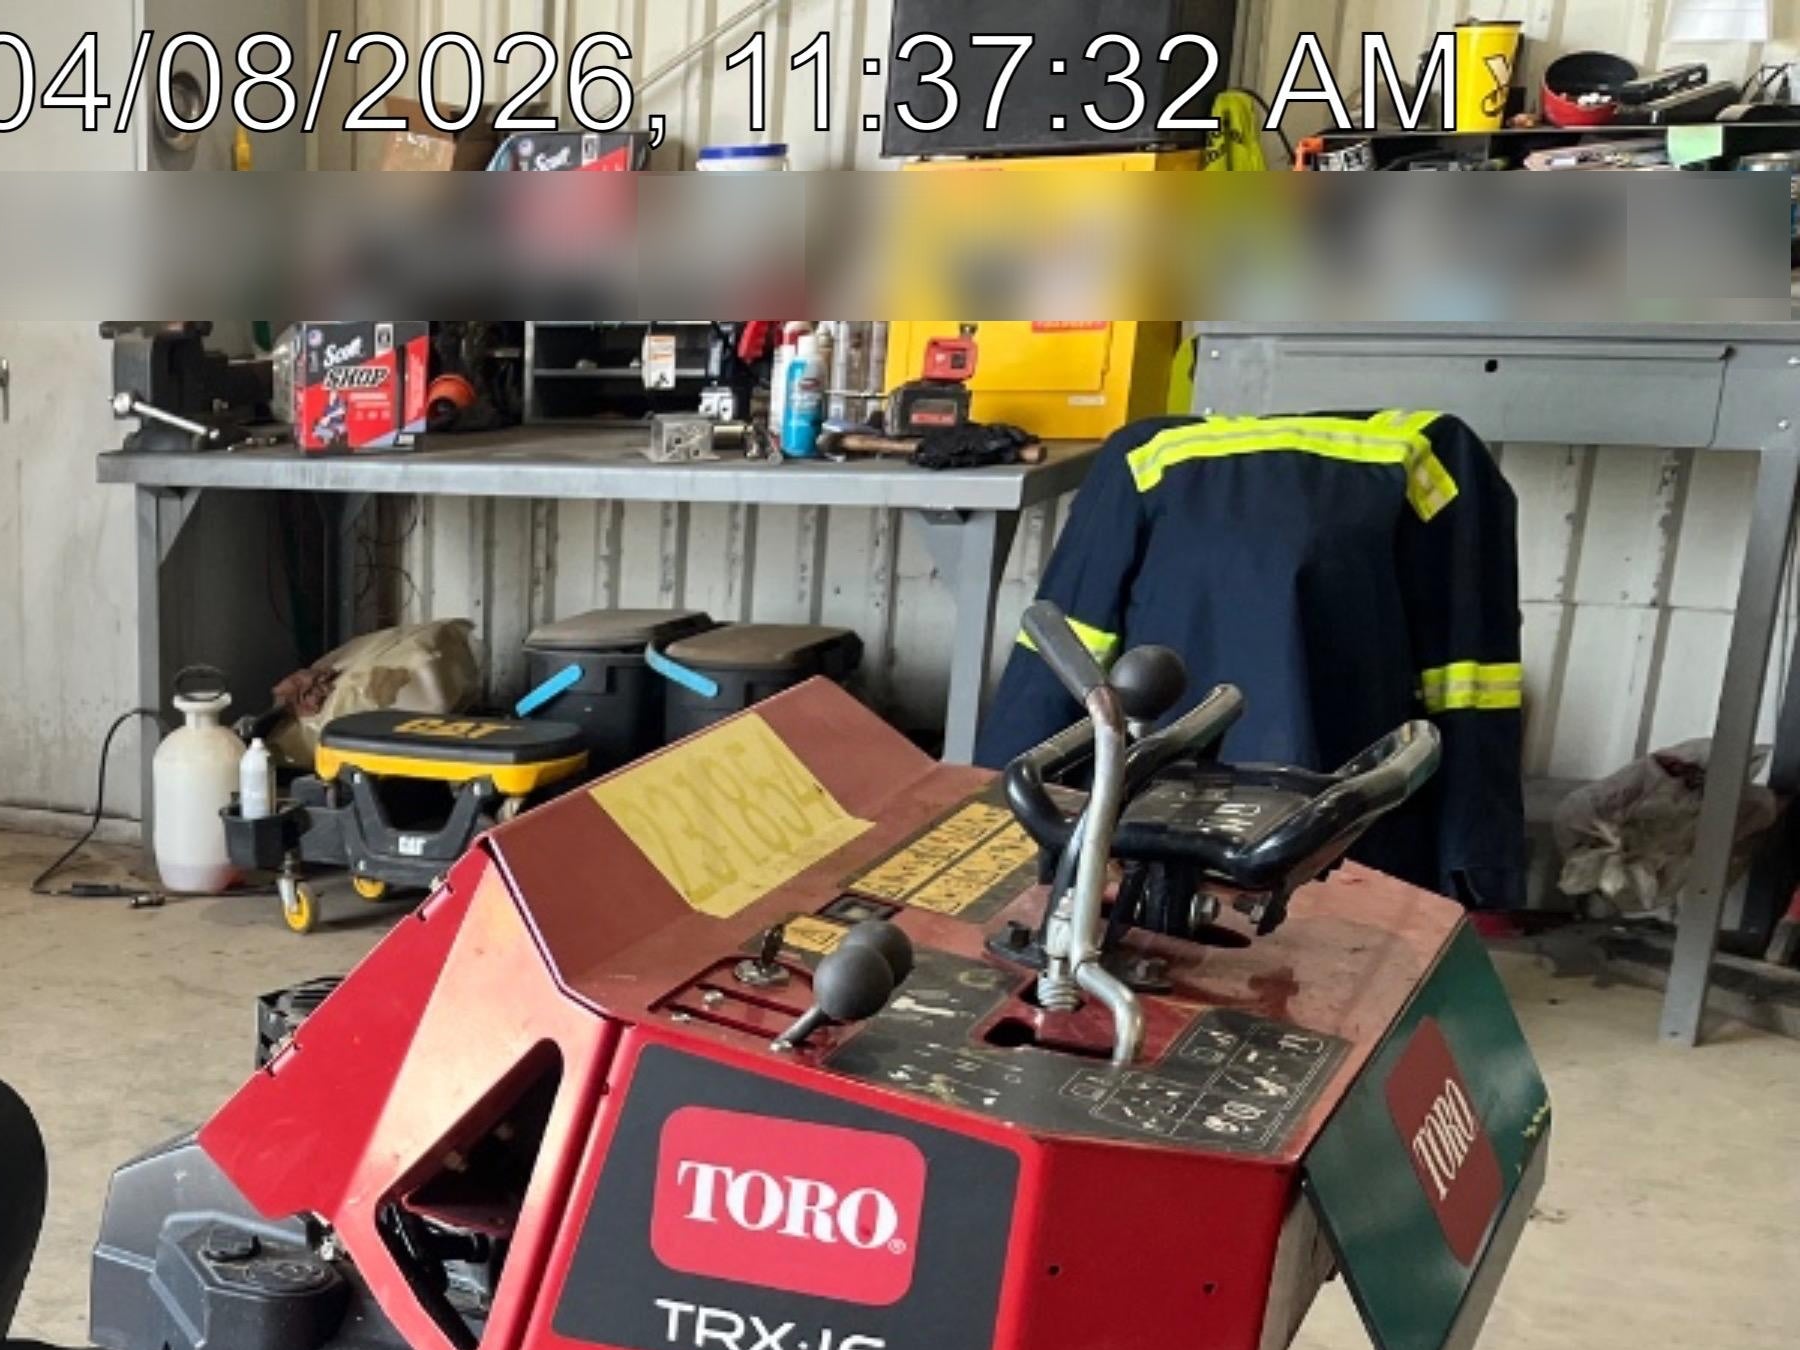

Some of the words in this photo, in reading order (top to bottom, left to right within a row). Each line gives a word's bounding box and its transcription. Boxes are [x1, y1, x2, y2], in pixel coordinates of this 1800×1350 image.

[392, 718, 508, 739] CAT
[397, 836, 427, 855] CAT
[1413, 1077, 1479, 1200] TORO
[677, 1160, 899, 1248] TORO
